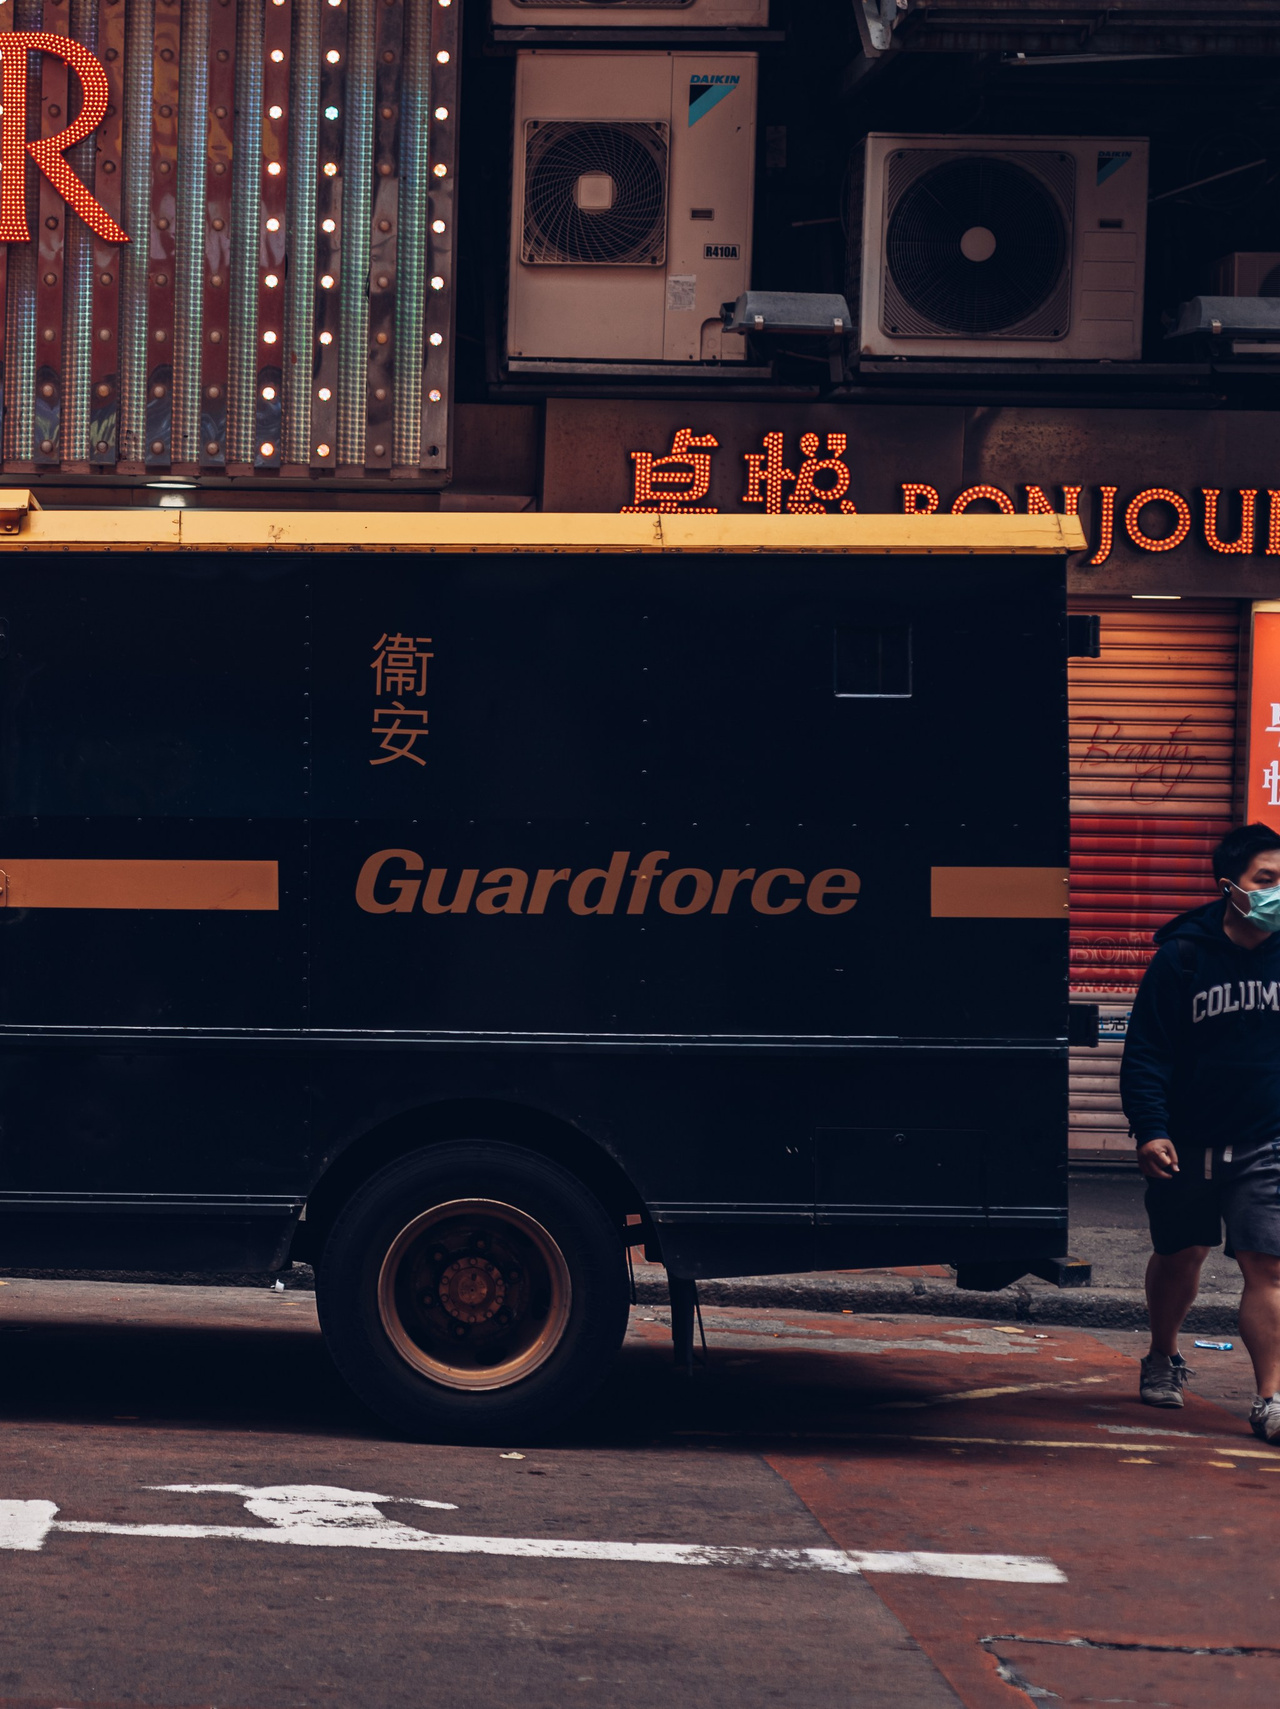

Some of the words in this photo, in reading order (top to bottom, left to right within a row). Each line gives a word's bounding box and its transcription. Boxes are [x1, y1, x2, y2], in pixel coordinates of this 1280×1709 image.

[690, 75, 740, 84] DAIKIN
[705, 246, 738, 258] R410A
[354, 848, 862, 916] Guardforce
